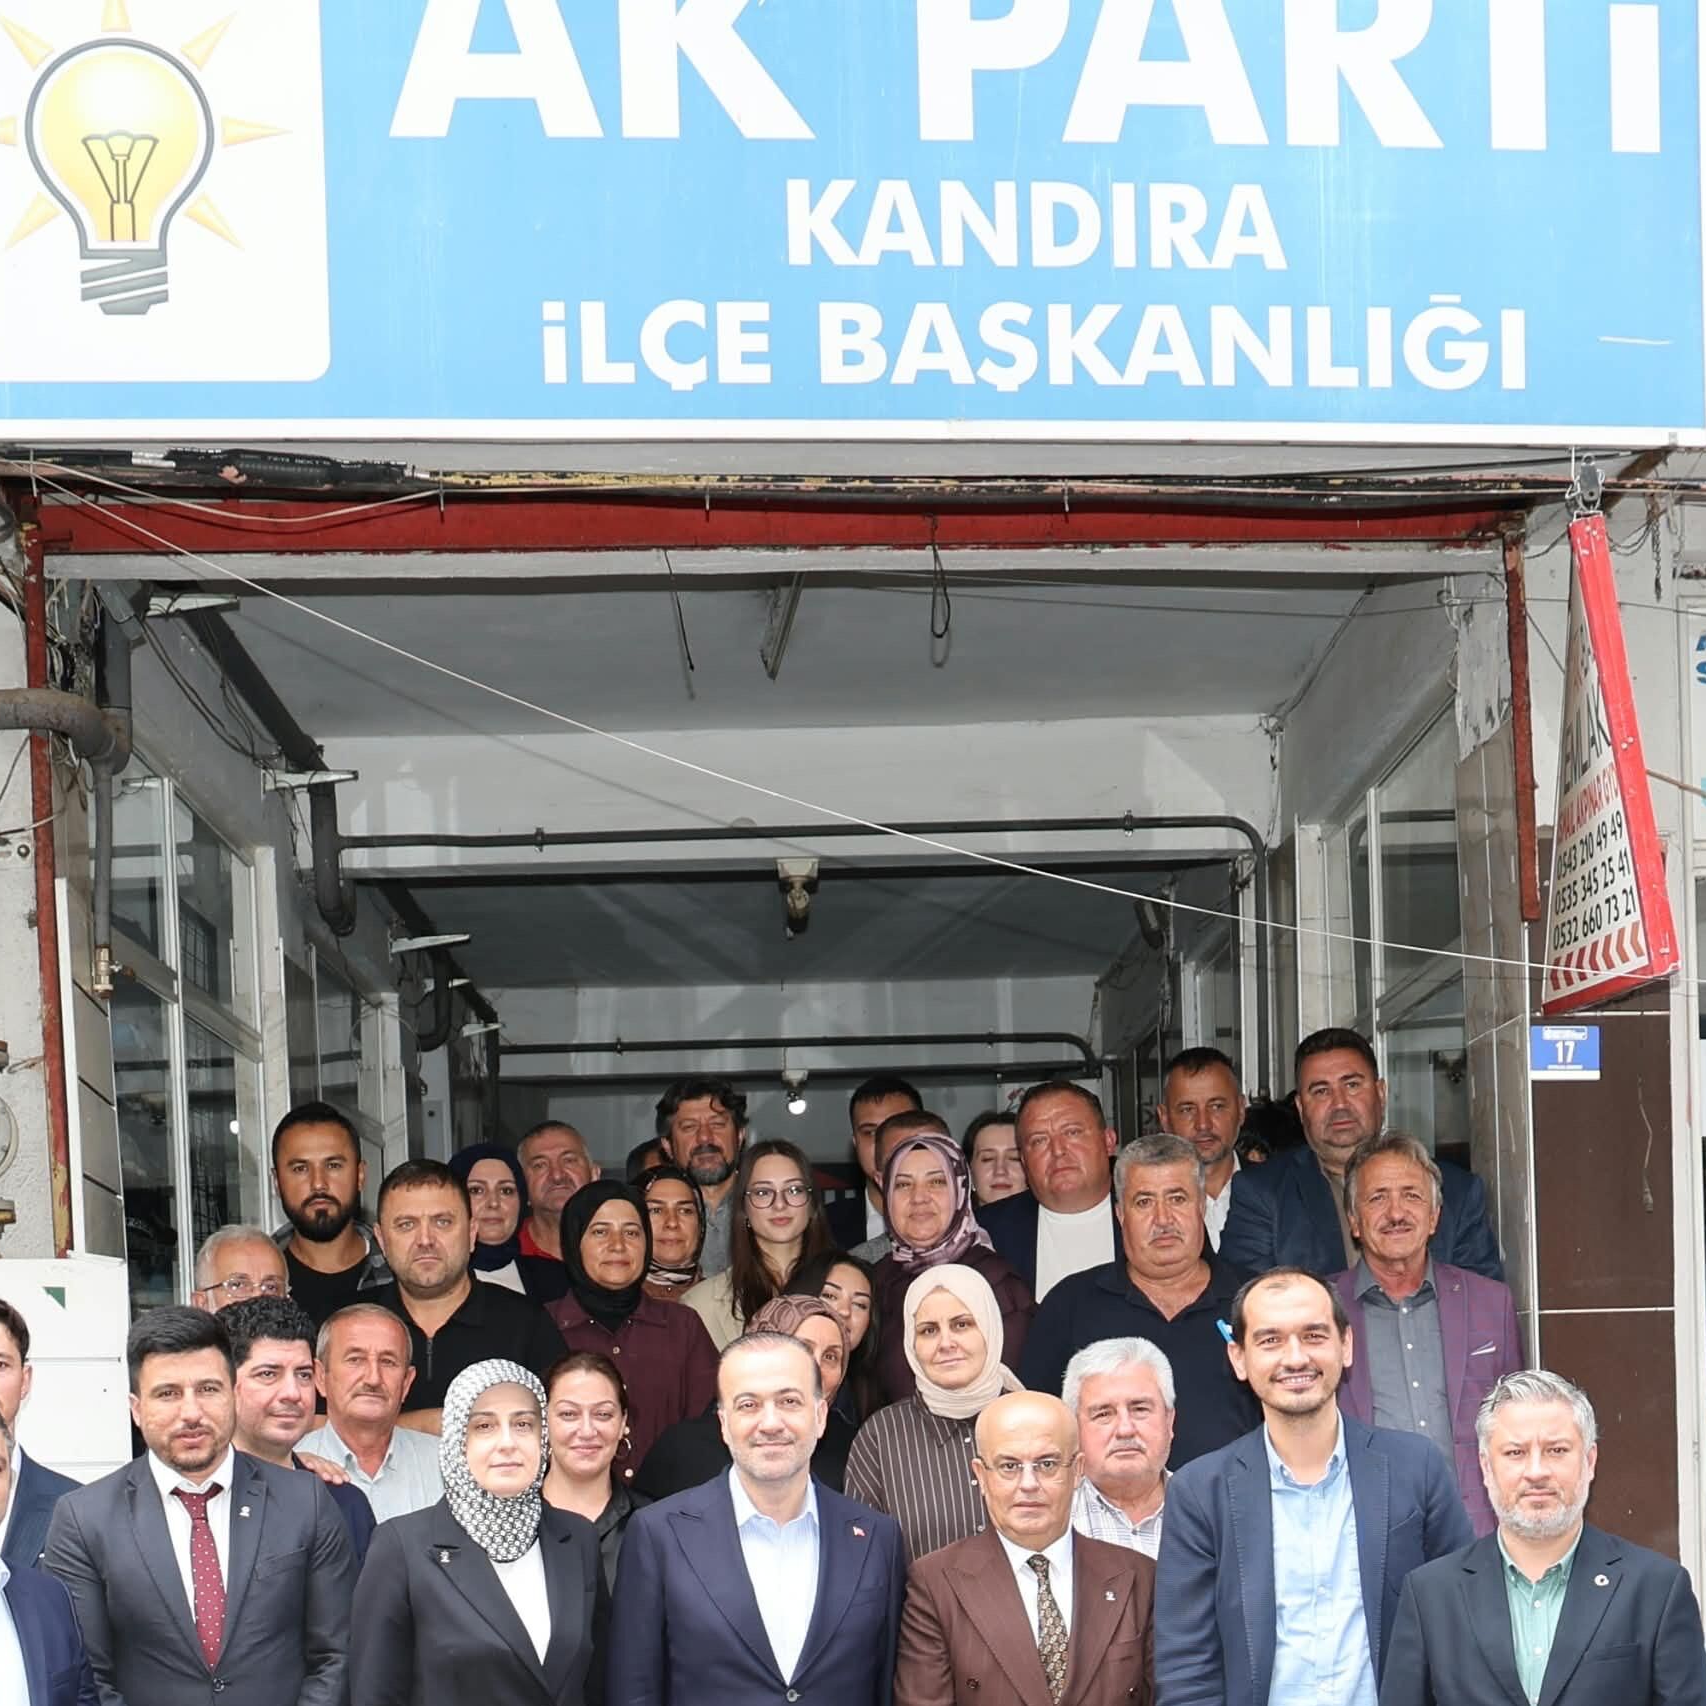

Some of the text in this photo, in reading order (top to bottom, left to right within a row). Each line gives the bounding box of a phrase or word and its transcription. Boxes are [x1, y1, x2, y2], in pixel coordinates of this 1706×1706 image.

[785, 179, 1289, 272] KANDIRA
[820, 291, 1528, 393] BAŞKANLIĞI
[1557, 845, 1577, 880] 0543
[1580, 832, 1593, 865] 210
[1596, 821, 1608, 852] 49
[1611, 810, 1623, 843] 49
[1555, 847, 1631, 915] 0535 345 25 41
[1553, 886, 1636, 951] 0532 660 73 21
[1555, 1041, 1575, 1064] 17
